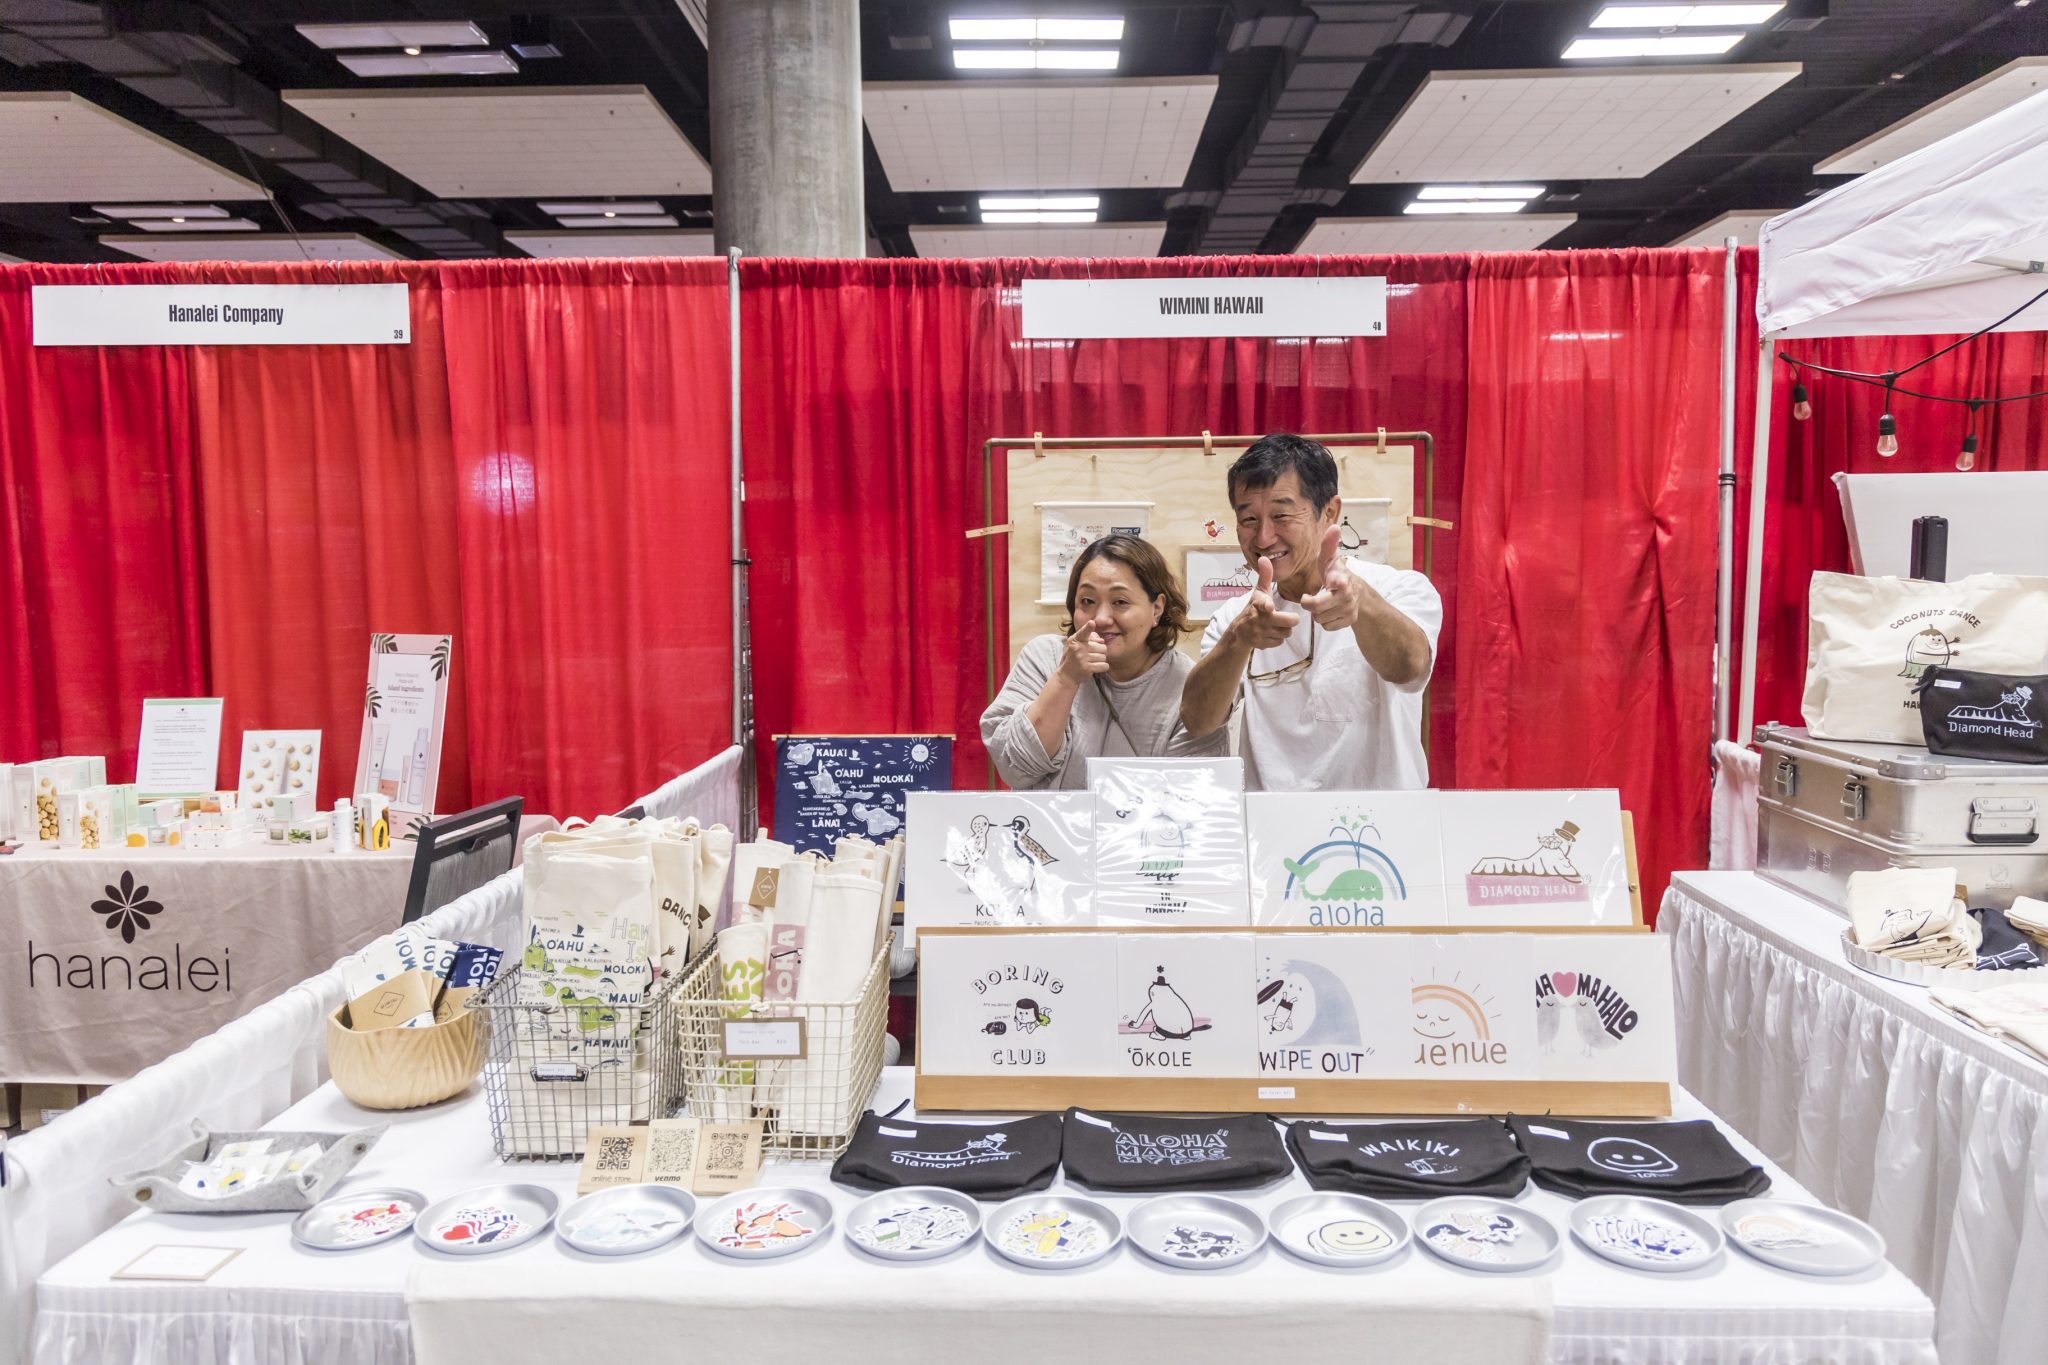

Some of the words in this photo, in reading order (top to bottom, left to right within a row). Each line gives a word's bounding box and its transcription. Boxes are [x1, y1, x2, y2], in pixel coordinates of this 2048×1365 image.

[1159, 297, 1210, 315] WIMINI
[1213, 296, 1264, 315] HAWAII
[168, 304, 219, 323] Hanalei
[222, 304, 285, 326] Company
[393, 329, 404, 340] 39
[1372, 321, 1382, 331] 40
[1889, 608, 1946, 630] COCONUTS
[1948, 609, 1982, 629] DANCE
[1947, 721, 2002, 736] Diamond
[2003, 726, 2035, 739] Head
[834, 768, 864, 778] O'AHU
[872, 773, 914, 784] MOLOKA'I
[1479, 884, 1541, 899] DIAMOND
[1543, 883, 1577, 897] HEAD
[1309, 902, 1384, 927] aloha
[546, 939, 585, 953] O'AHU
[28, 939, 231, 993] hanalei
[970, 964, 1065, 995] BORING
[1576, 973, 1640, 1041] MAHALO
[991, 1049, 1047, 1065] CLUB
[1259, 1049, 1313, 1072] WIPE
[1115, 1144, 1226, 1159] MAKES
[1358, 1139, 1461, 1157] WAIKIKI
[890, 1154, 966, 1169] Diamond
[969, 1154, 1010, 1165] Head
[654, 1175, 682, 1183] venmo
